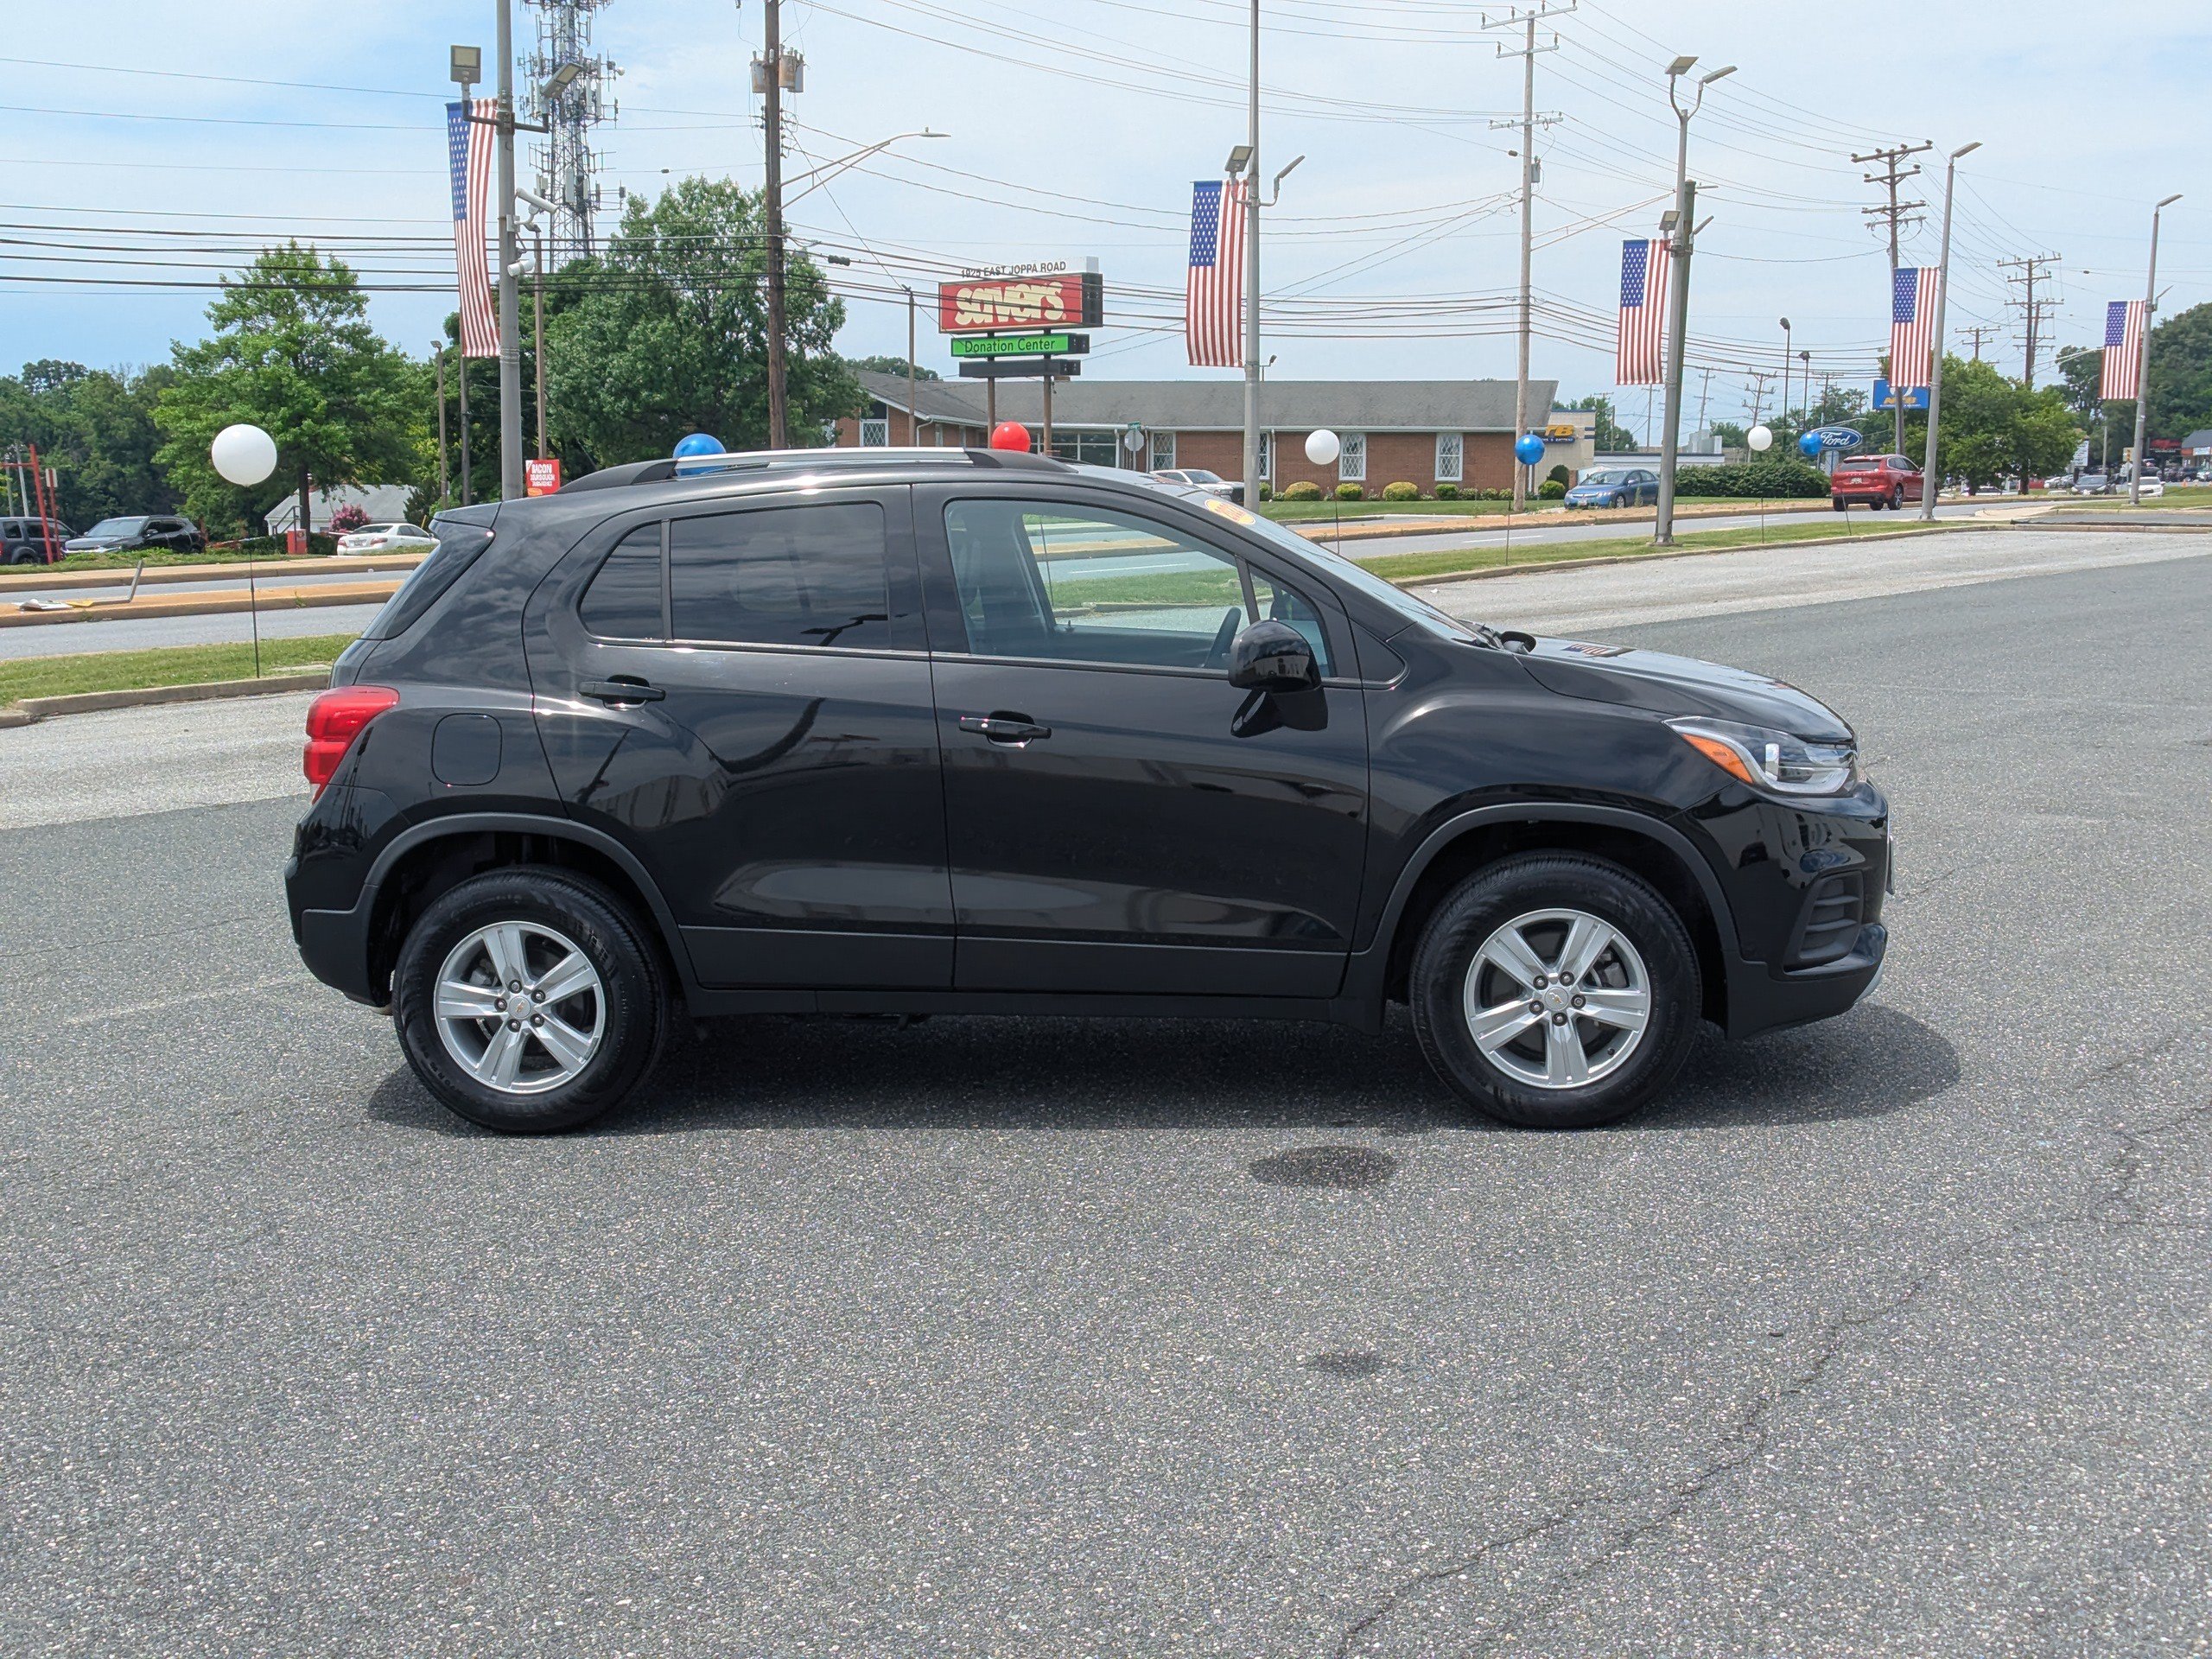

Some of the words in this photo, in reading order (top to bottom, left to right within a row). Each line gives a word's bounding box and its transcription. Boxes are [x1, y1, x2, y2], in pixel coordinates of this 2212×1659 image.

[983, 265, 1006, 276] EAST
[1009, 263, 1038, 275] JOPPA
[1040, 261, 1067, 273] ROAD
[964, 339, 1014, 353] Donation
[1017, 337, 1056, 351] Center
[1820, 431, 1851, 446] Ford
